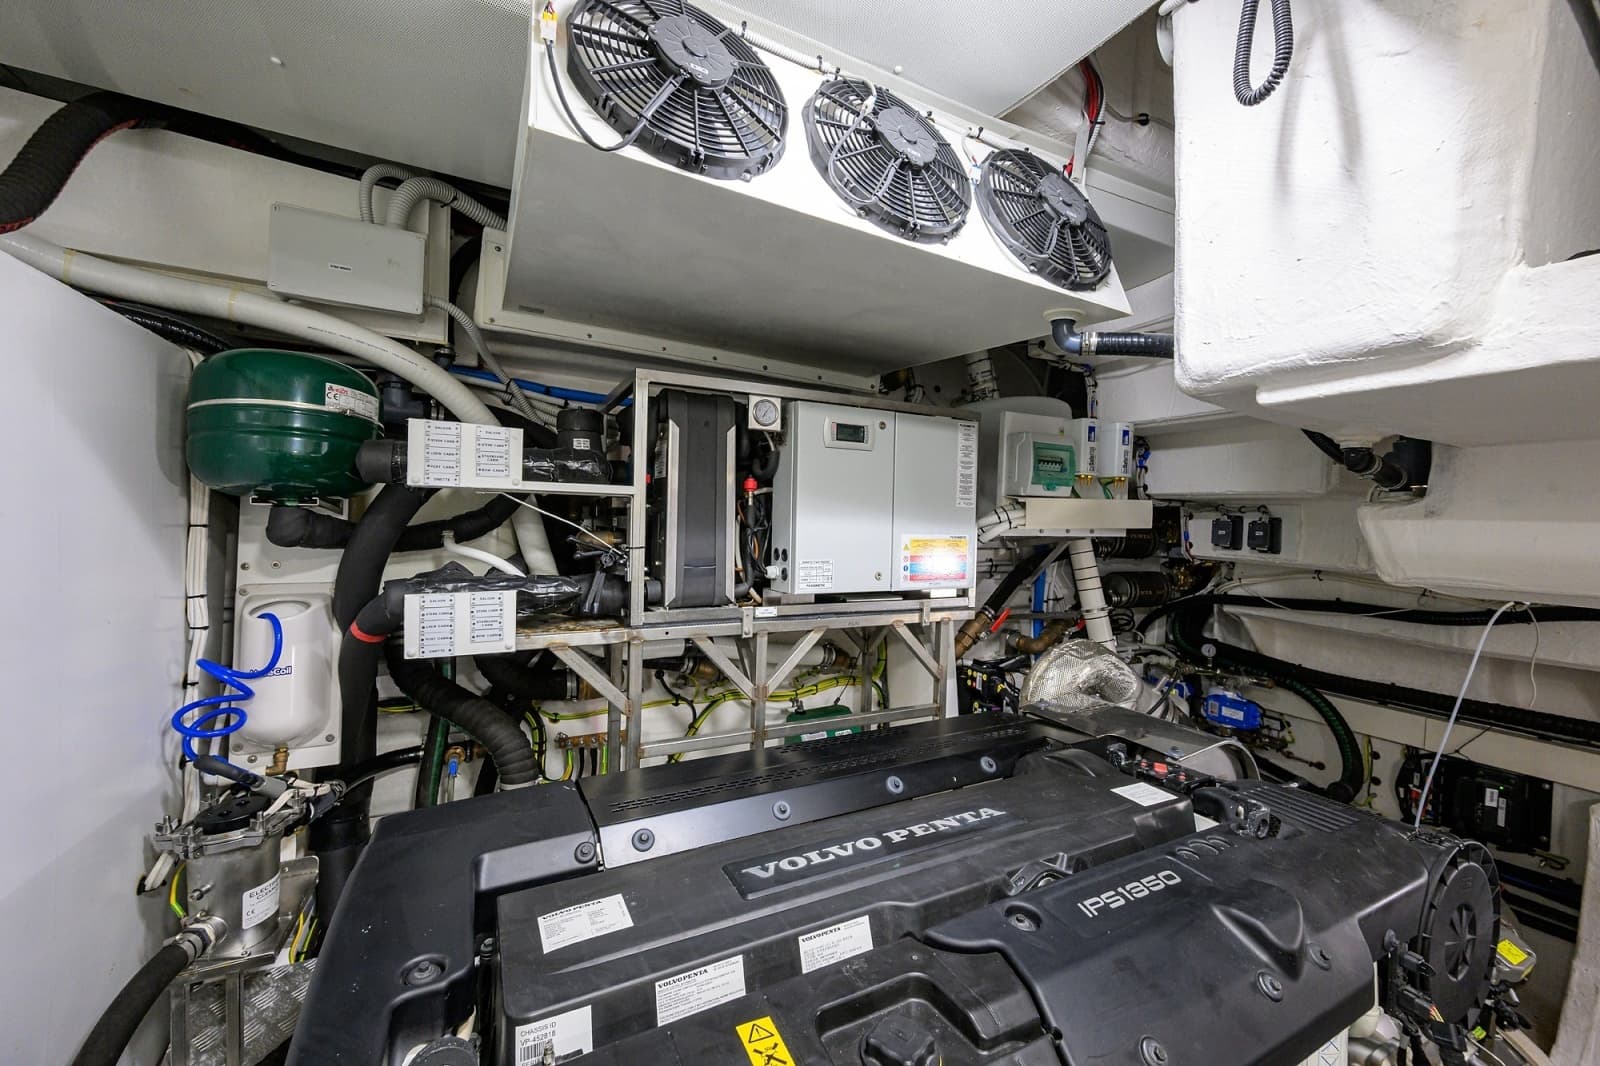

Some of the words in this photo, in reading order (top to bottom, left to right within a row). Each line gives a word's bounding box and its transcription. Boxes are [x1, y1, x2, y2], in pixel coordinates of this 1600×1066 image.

[742, 836, 882, 879] VOLVO
[882, 807, 1006, 844] PENTA
[1077, 870, 1182, 918] IPS1350
[520, 1023, 548, 1037] CHASSIS
